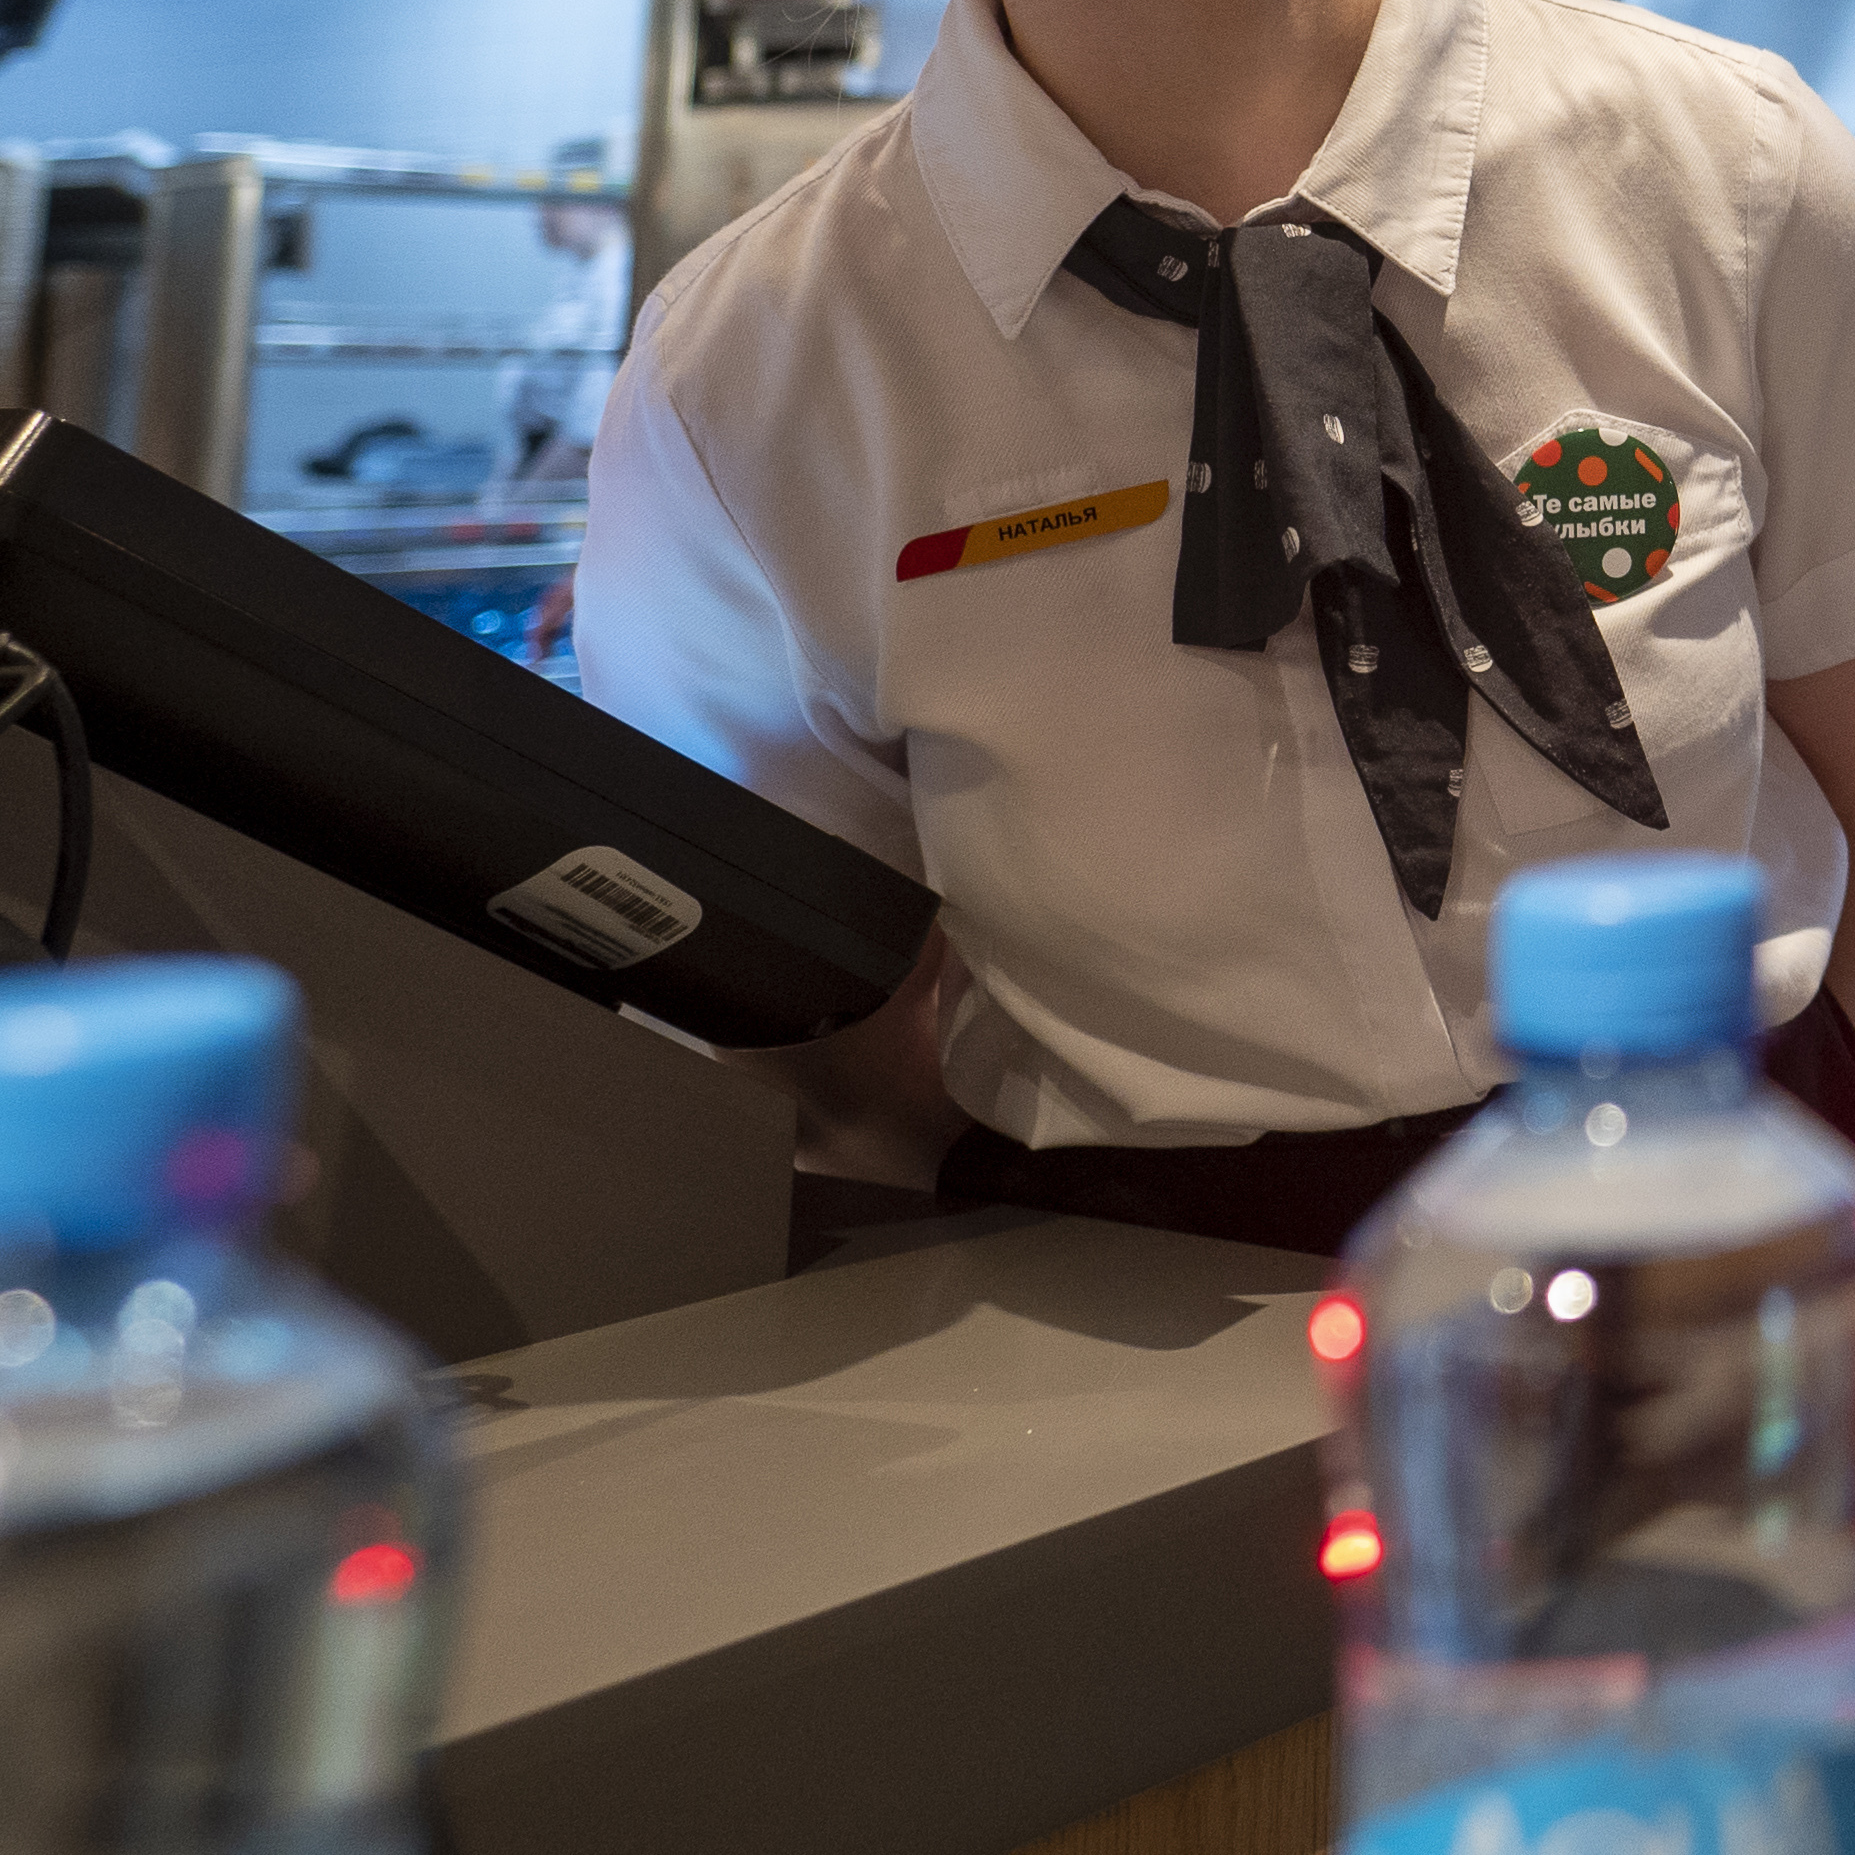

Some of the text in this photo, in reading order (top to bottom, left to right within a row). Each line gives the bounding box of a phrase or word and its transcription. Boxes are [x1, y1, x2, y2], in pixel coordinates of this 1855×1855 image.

[1533, 492, 1657, 515] Те самые
[998, 507, 1098, 542] НАТАЛЬЯ
